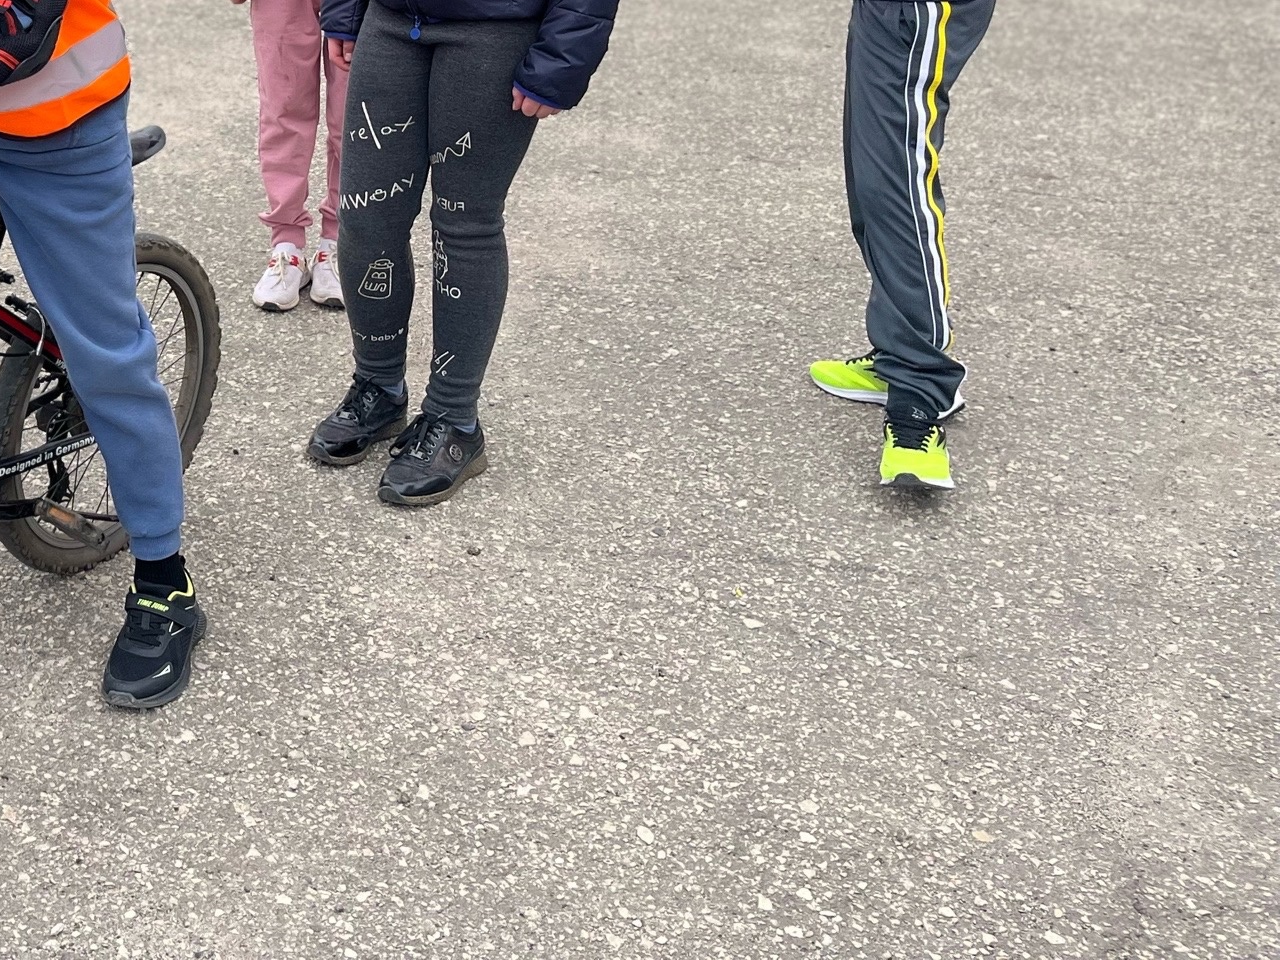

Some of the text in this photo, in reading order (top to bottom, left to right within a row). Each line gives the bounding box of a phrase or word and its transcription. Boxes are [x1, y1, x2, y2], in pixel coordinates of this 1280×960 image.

[349, 101, 416, 150] relax
[370, 331, 398, 342] baby
[44, 451, 54, 461] in
[55, 435, 96, 457] Germany
[137, 598, 169, 612] TIME JUMP
